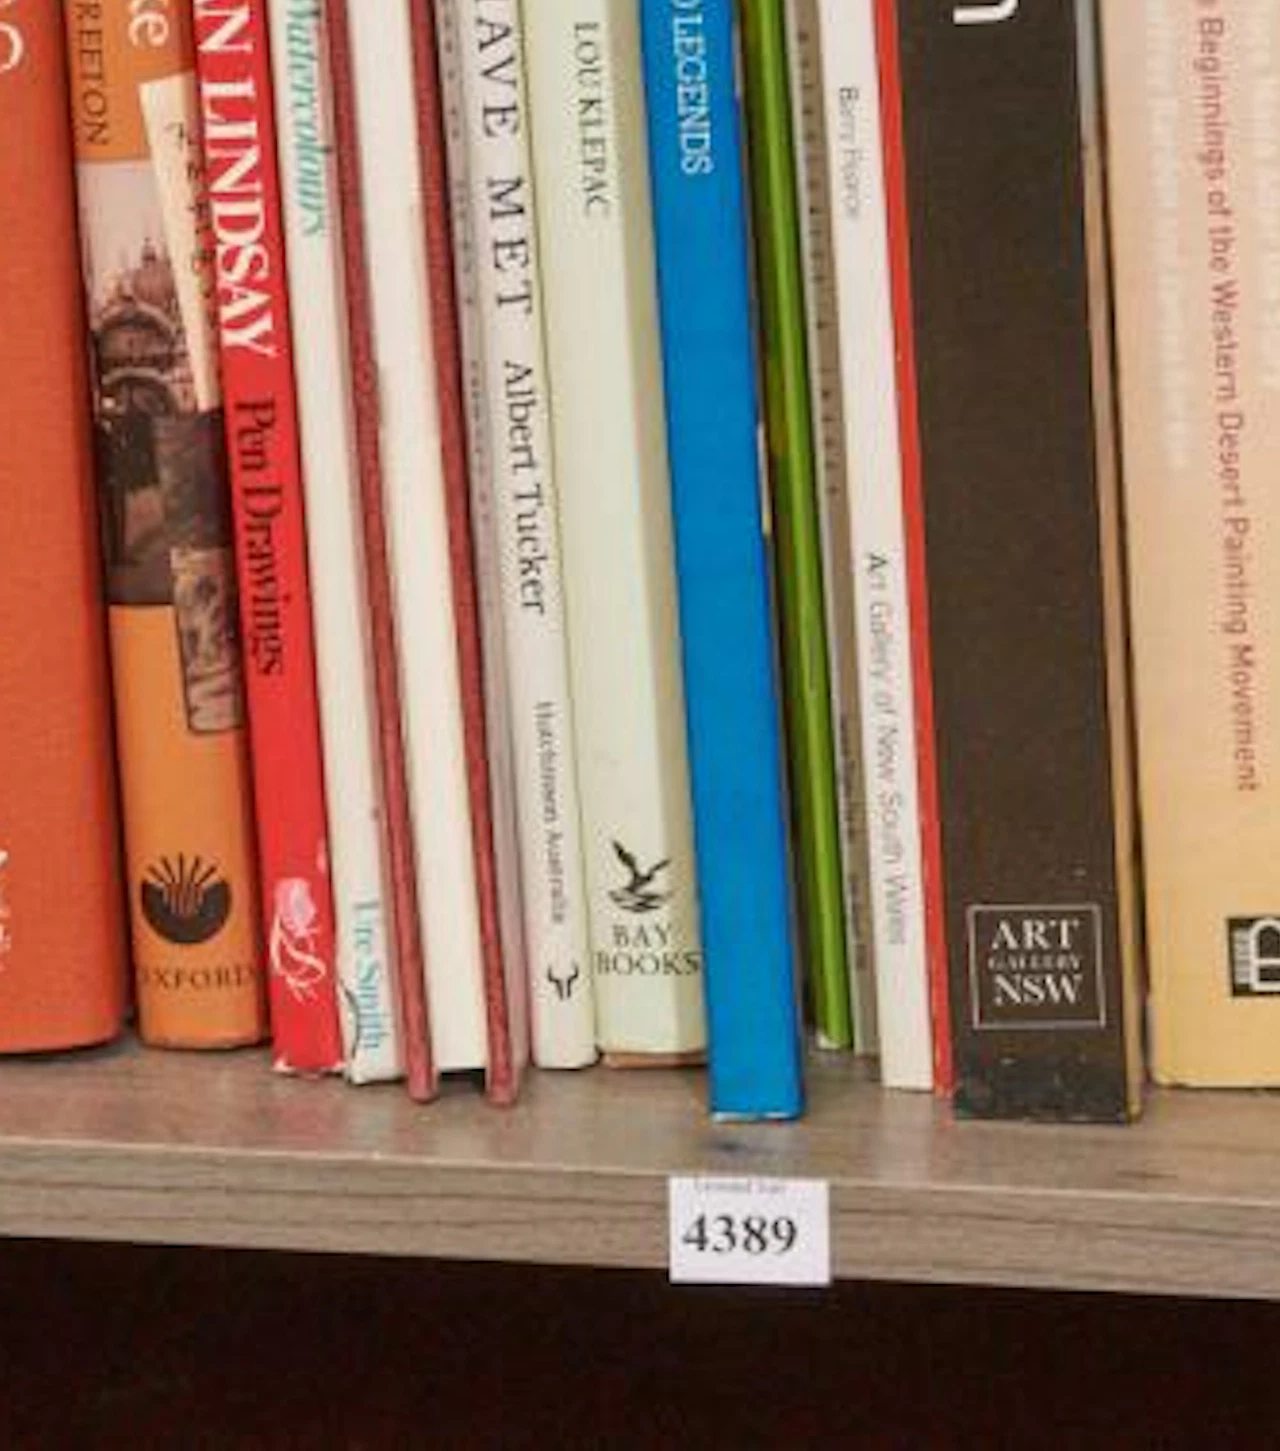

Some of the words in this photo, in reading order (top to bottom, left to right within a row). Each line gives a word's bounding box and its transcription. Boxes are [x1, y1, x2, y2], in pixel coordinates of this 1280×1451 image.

[571, 20, 602, 93] LOU
[672, 14, 714, 176] LEGENDS
[1195, 16, 1228, 182] Beginnings
[577, 96, 611, 221] KLEPAC
[1207, 189, 1233, 220] of
[201, 74, 278, 360] LINDSAY
[487, 174, 535, 316] MET
[1209, 226, 1236, 270] the
[1210, 277, 1242, 402] Western
[234, 399, 280, 474] Pen
[503, 360, 539, 474] Albert
[1218, 410, 1247, 507] Desert
[242, 484, 291, 679] Drawings
[514, 482, 550, 617] Tucker
[1221, 514, 1253, 634] Painting
[876, 727, 902, 782] New
[1229, 643, 1261, 792] Movement
[880, 791, 905, 868] South
[597, 949, 702, 976] BOOKS
[612, 923, 672, 948] BAY
[991, 918, 1080, 950] ART
[357, 959, 391, 1051] Smith
[994, 972, 1083, 1006] NSW
[681, 1212, 799, 1256] 4389
